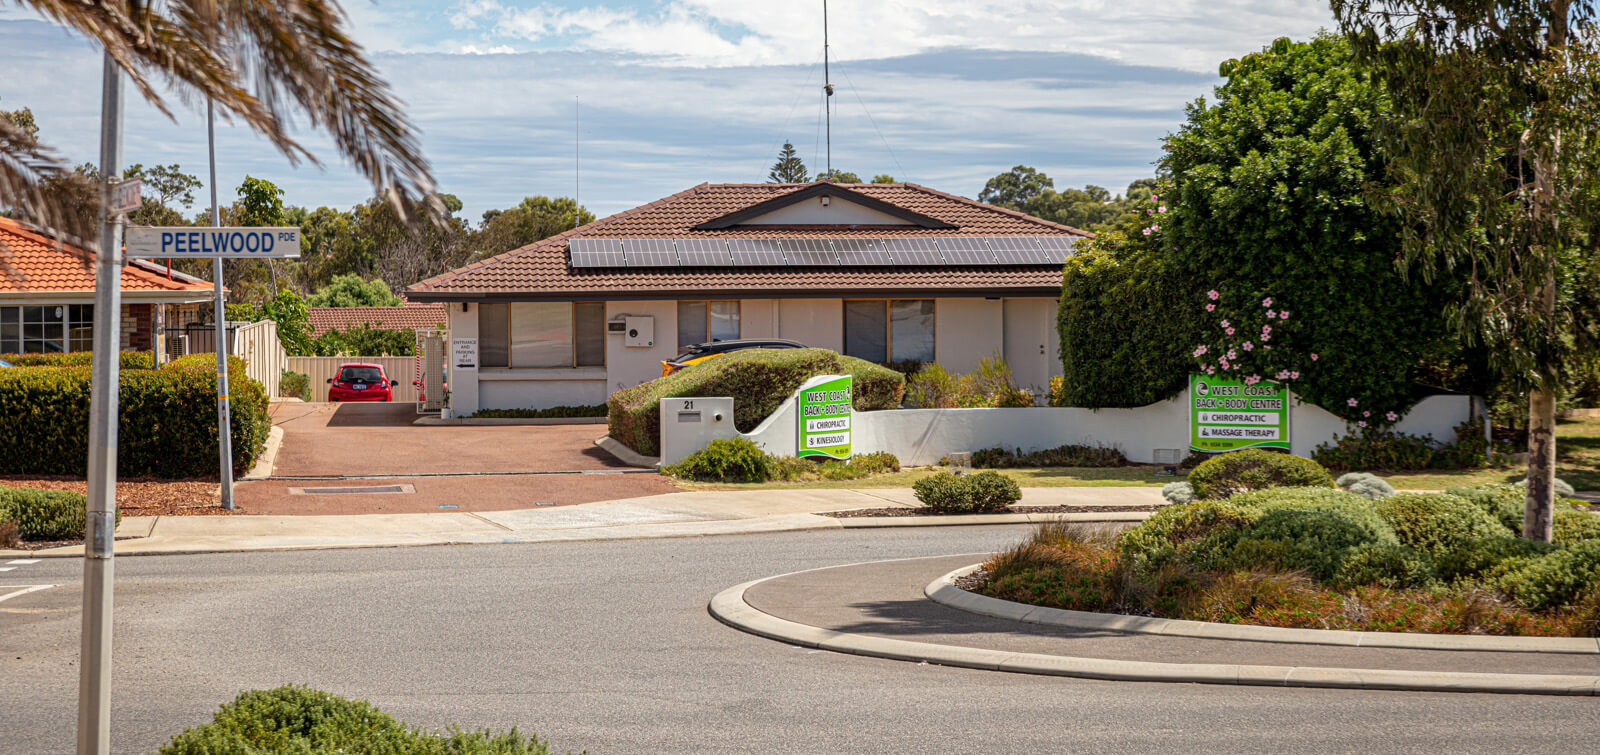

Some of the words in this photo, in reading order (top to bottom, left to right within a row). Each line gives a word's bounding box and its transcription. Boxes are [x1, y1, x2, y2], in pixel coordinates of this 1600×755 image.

[161, 232, 275, 253] PEELWOOD
[278, 232, 296, 242] PDE
[1211, 386, 1239, 396] WEST
[807, 392, 827, 402] WEST
[829, 390, 845, 401] COAST
[683, 400, 694, 409] 21
[1196, 398, 1216, 408] BACK
[1225, 399, 1247, 409] BODY
[1250, 399, 1282, 409] CENTRE
[804, 405, 821, 416] BACK
[826, 404, 838, 415] BODY
[1211, 414, 1266, 422] CHIROPRACTIC
[816, 420, 846, 429] CHIROPRACTIC
[1211, 429, 1242, 437] MASSAGE
[1245, 429, 1275, 437] THERAPY
[816, 436, 845, 445] KINESIOLOGY
